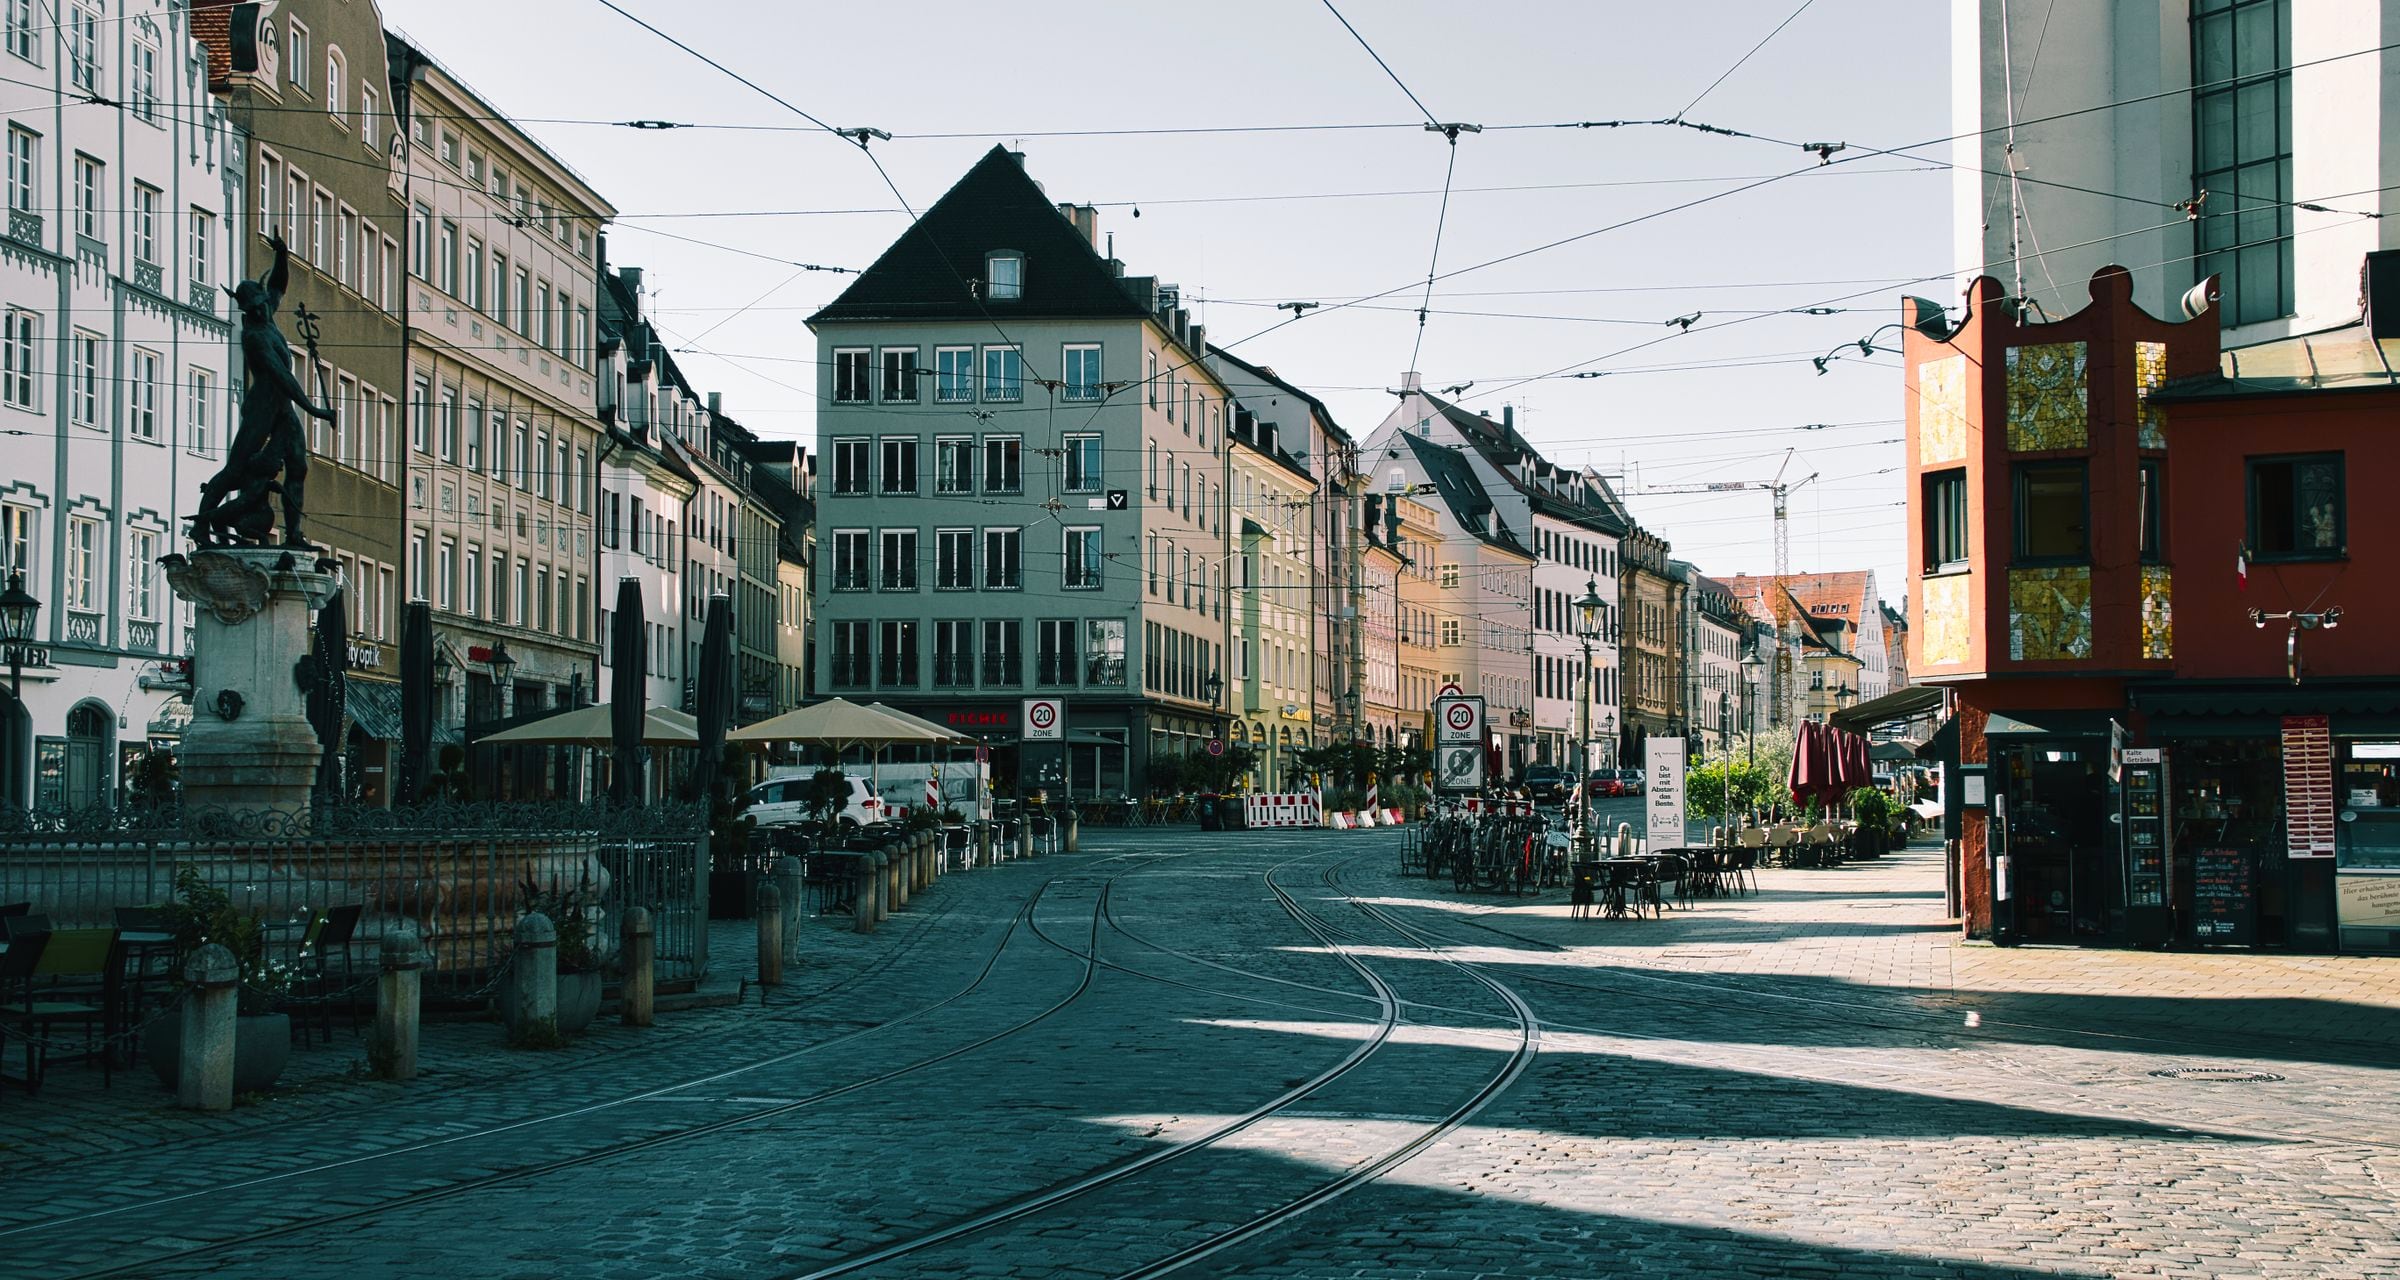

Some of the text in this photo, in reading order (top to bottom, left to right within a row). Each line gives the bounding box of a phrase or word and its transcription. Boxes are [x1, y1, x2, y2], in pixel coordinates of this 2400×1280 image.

[360, 646, 380, 669] optik
[1036, 709, 1050, 722] 20
[1453, 711, 1468, 723] 20
[2358, 885, 2385, 893] erhalten
